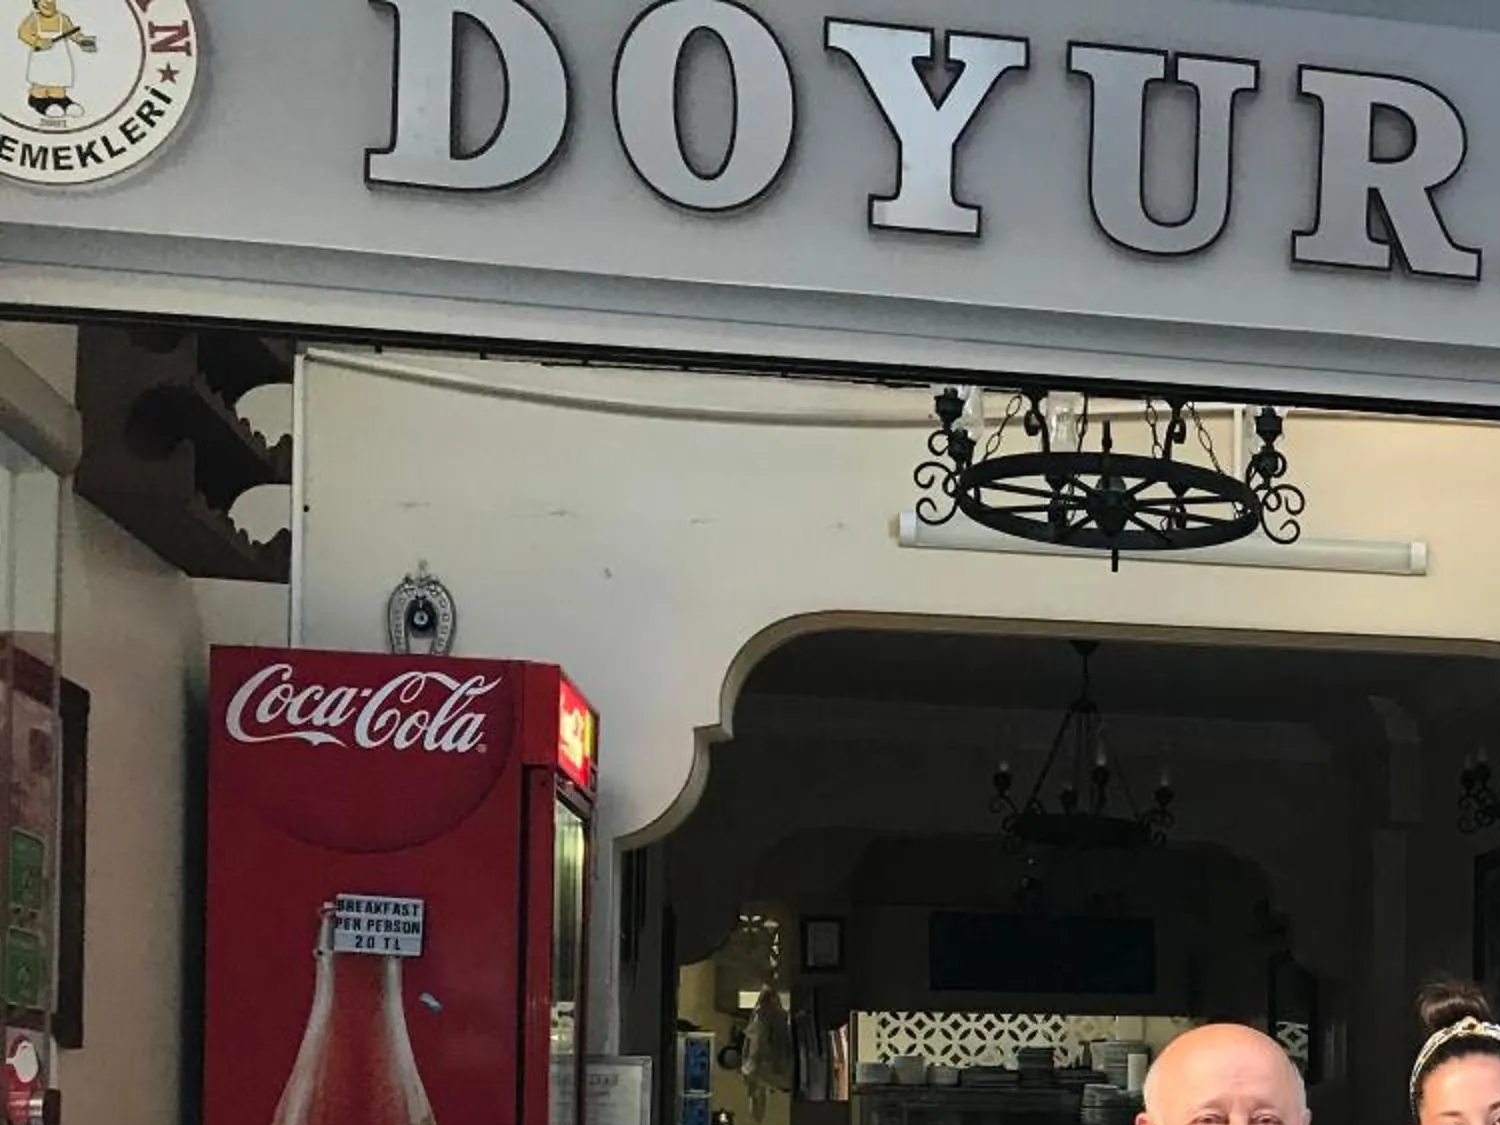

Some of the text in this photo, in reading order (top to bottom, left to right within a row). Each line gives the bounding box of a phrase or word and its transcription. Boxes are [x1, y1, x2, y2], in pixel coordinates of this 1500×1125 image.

[225, 663, 501, 753] Coca-Cola
[337, 899, 420, 917] BREAKFAST
[335, 918, 420, 935] PER PERSON
[355, 935, 402, 951] 20 TL
